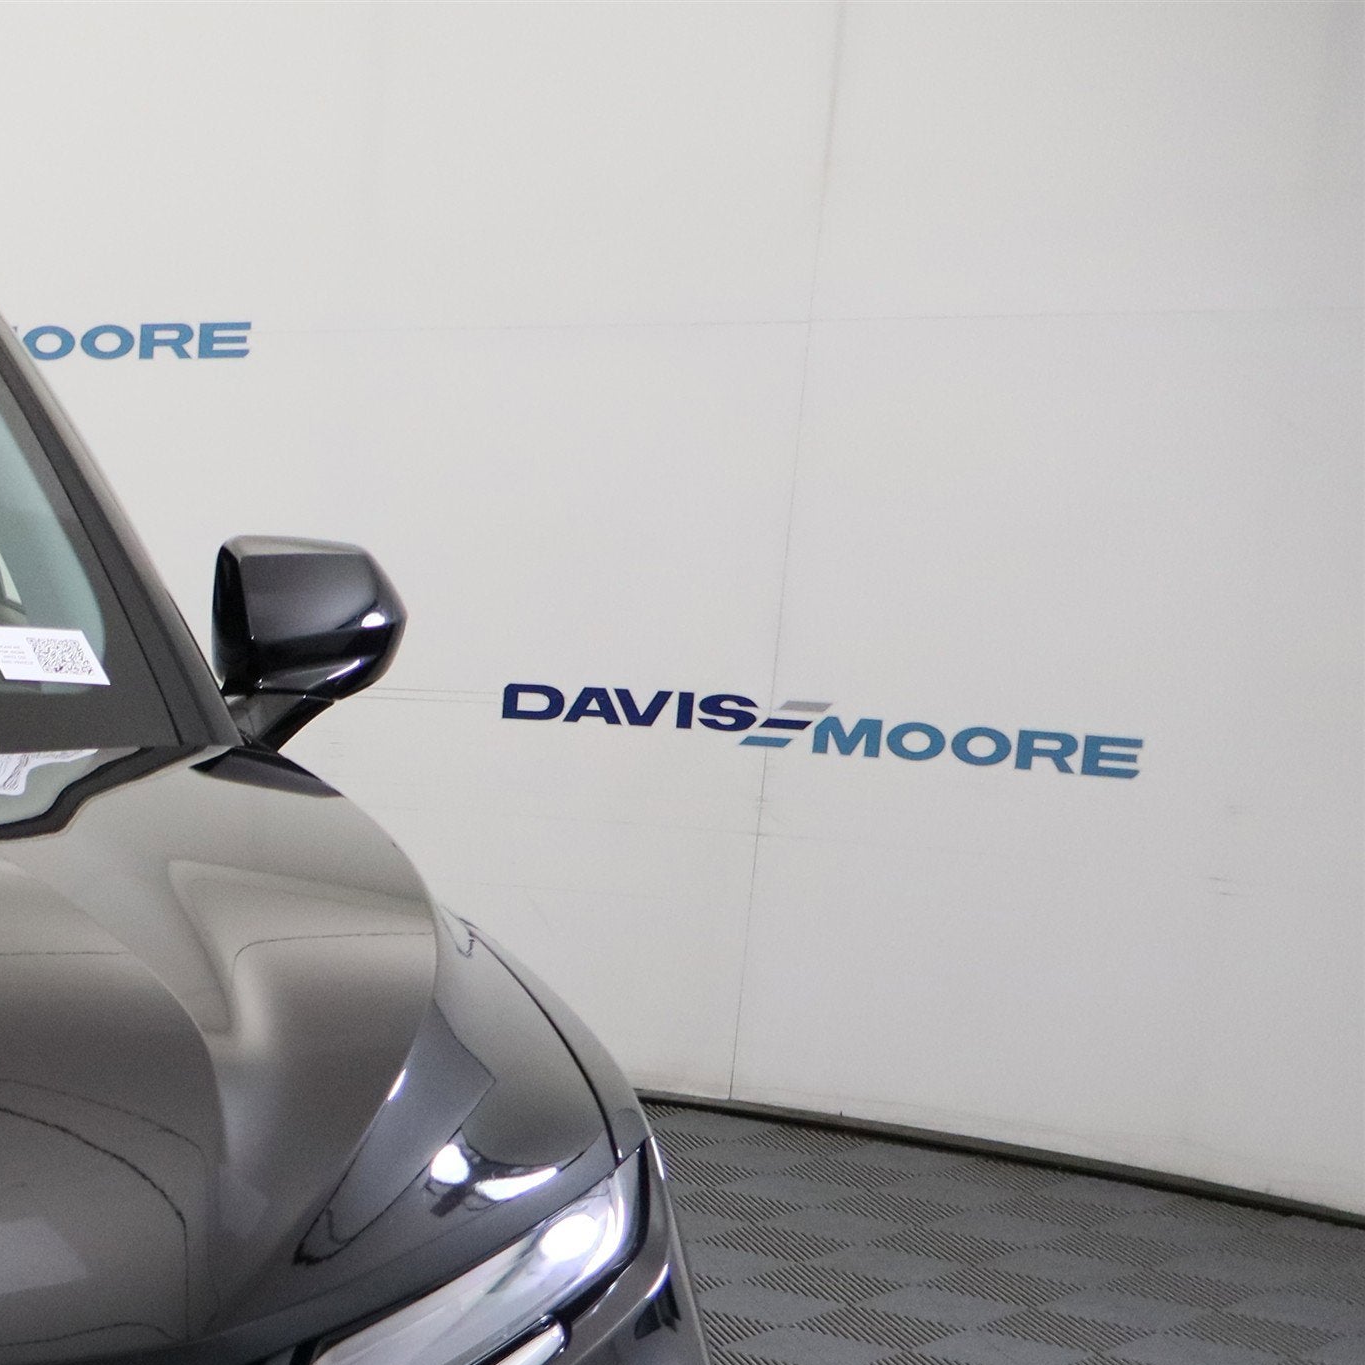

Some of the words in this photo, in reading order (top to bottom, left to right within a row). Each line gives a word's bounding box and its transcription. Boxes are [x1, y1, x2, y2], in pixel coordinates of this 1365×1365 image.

[14, 321, 252, 361] OORE
[501, 682, 759, 733] DAVIS
[811, 715, 1145, 780] MOORE
